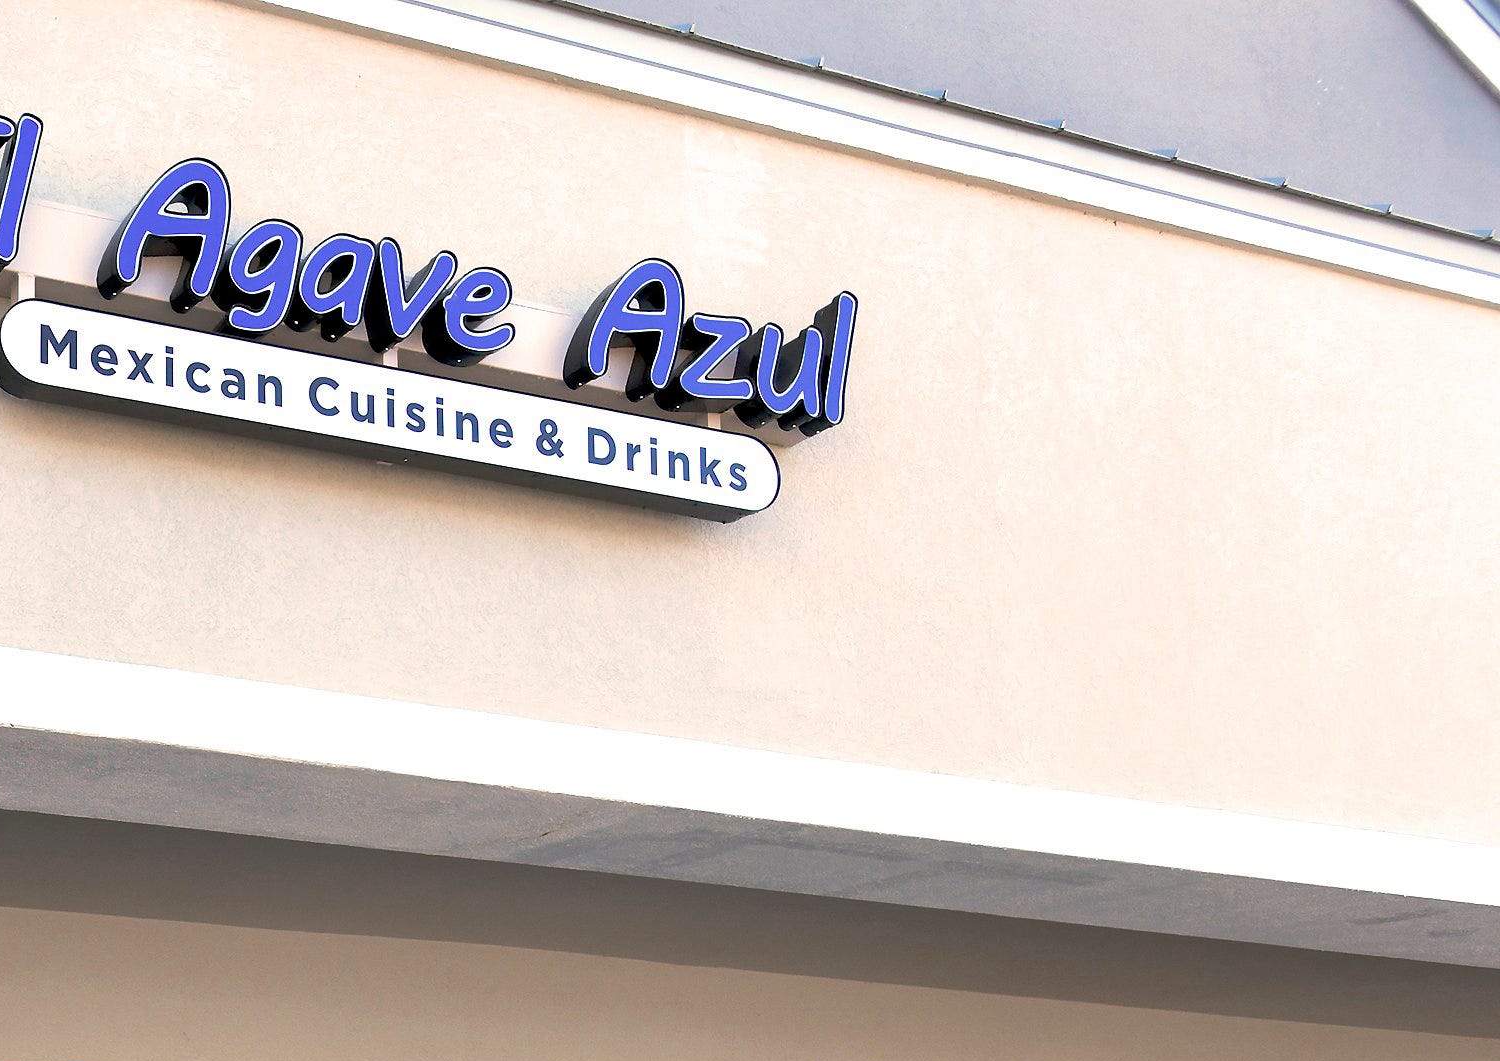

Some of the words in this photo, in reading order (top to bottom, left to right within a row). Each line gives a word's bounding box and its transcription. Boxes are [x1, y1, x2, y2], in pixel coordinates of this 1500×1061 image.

[106, 157, 516, 360] Agave
[578, 258, 859, 430] Azul
[39, 324, 283, 408] Mexican
[308, 375, 514, 449] Cuisine
[536, 420, 566, 458] &
[588, 430, 750, 493] Drinks
